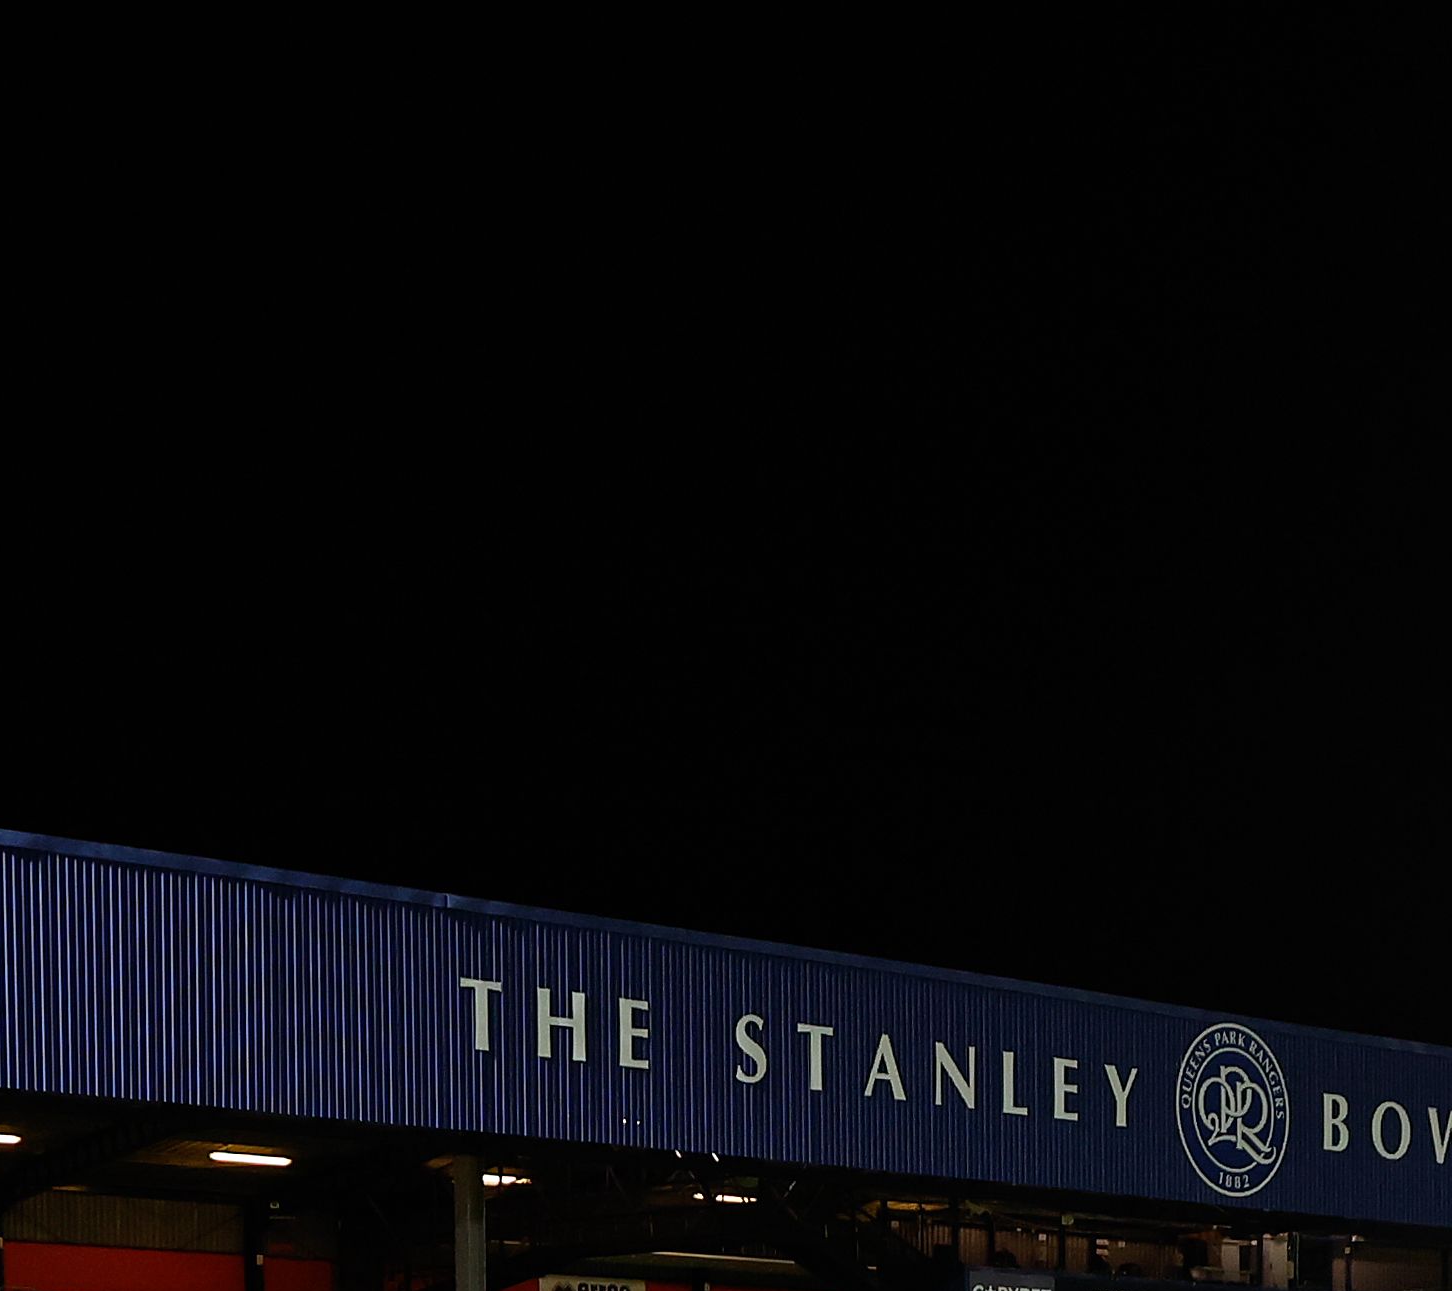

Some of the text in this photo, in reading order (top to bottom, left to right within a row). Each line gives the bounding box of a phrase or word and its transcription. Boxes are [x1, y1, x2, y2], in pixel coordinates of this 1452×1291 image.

[460, 977, 1138, 1127] THE STANLEY
[1181, 1031, 1284, 1120] QUEENS PARK RANGERS
[1218, 1172, 1250, 1189] 1882
